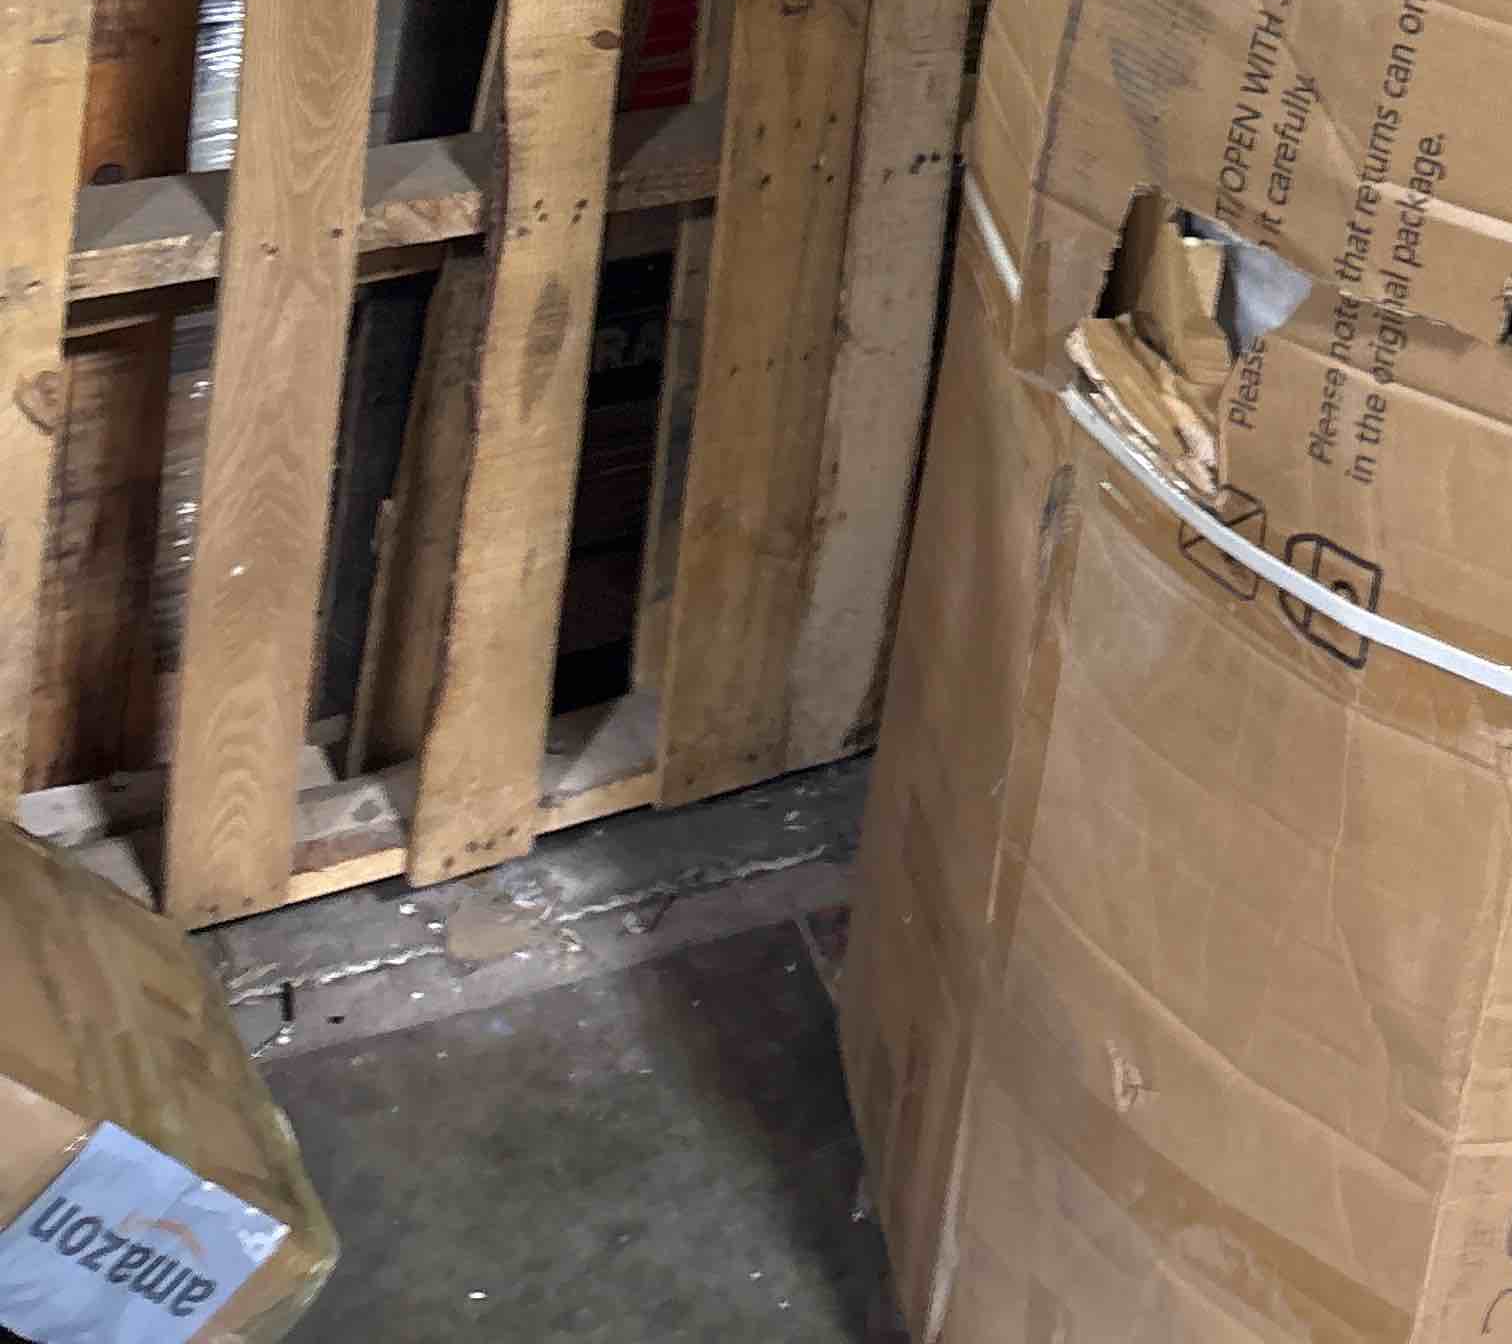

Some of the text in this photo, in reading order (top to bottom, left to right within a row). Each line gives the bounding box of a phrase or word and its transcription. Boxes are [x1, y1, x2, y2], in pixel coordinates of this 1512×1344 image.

[1241, 9, 1283, 100] WITH
[1384, 35, 1416, 100] can
[1352, 104, 1402, 209] returns
[1333, 204, 1370, 285] that
[1330, 288, 1361, 364] note
[1344, 131, 1447, 486] in the original package.
[1307, 367, 1348, 467] Please
[28, 1196, 217, 1317] amazon
